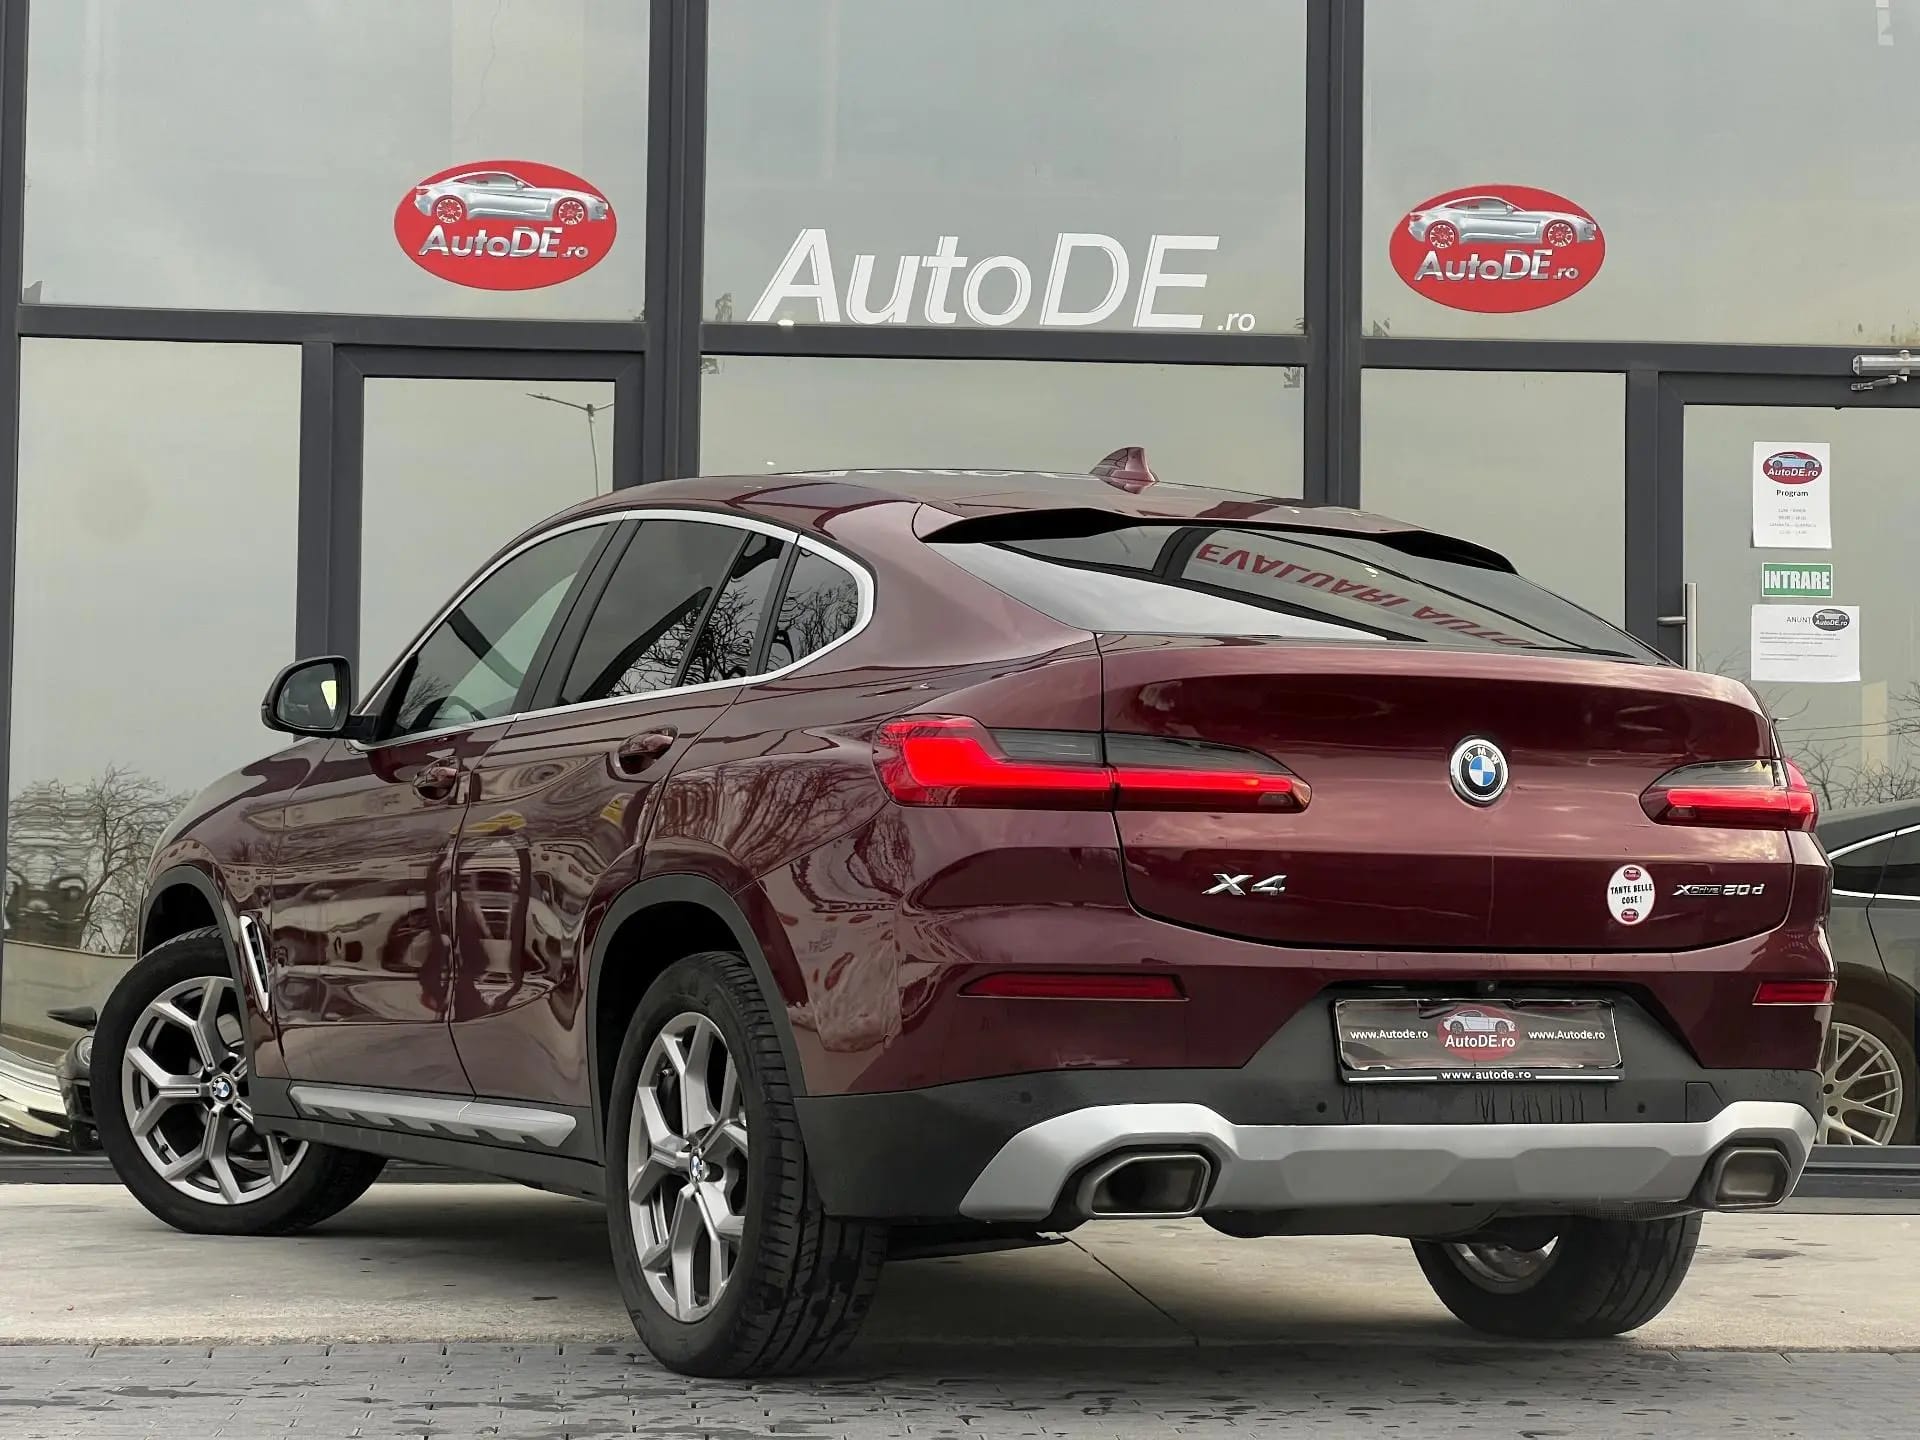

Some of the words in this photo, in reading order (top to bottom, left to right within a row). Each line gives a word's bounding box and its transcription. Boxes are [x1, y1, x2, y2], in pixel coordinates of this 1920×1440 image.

[1767, 468, 1819, 477] AutoDE.ro
[1776, 489, 1809, 497] Program
[1764, 570, 1830, 590] INTRARE
[1465, 747, 1500, 765] BMW
[1610, 885, 1632, 895] TANTE
[1633, 883, 1653, 893] BELLE
[1350, 1029, 1429, 1040] www.Autode.ro
[1528, 1029, 1606, 1040] www.Autode.ro
[1444, 1034, 1516, 1048] AutoDE.ro
[1441, 1070, 1532, 1080] www.autode.ro
